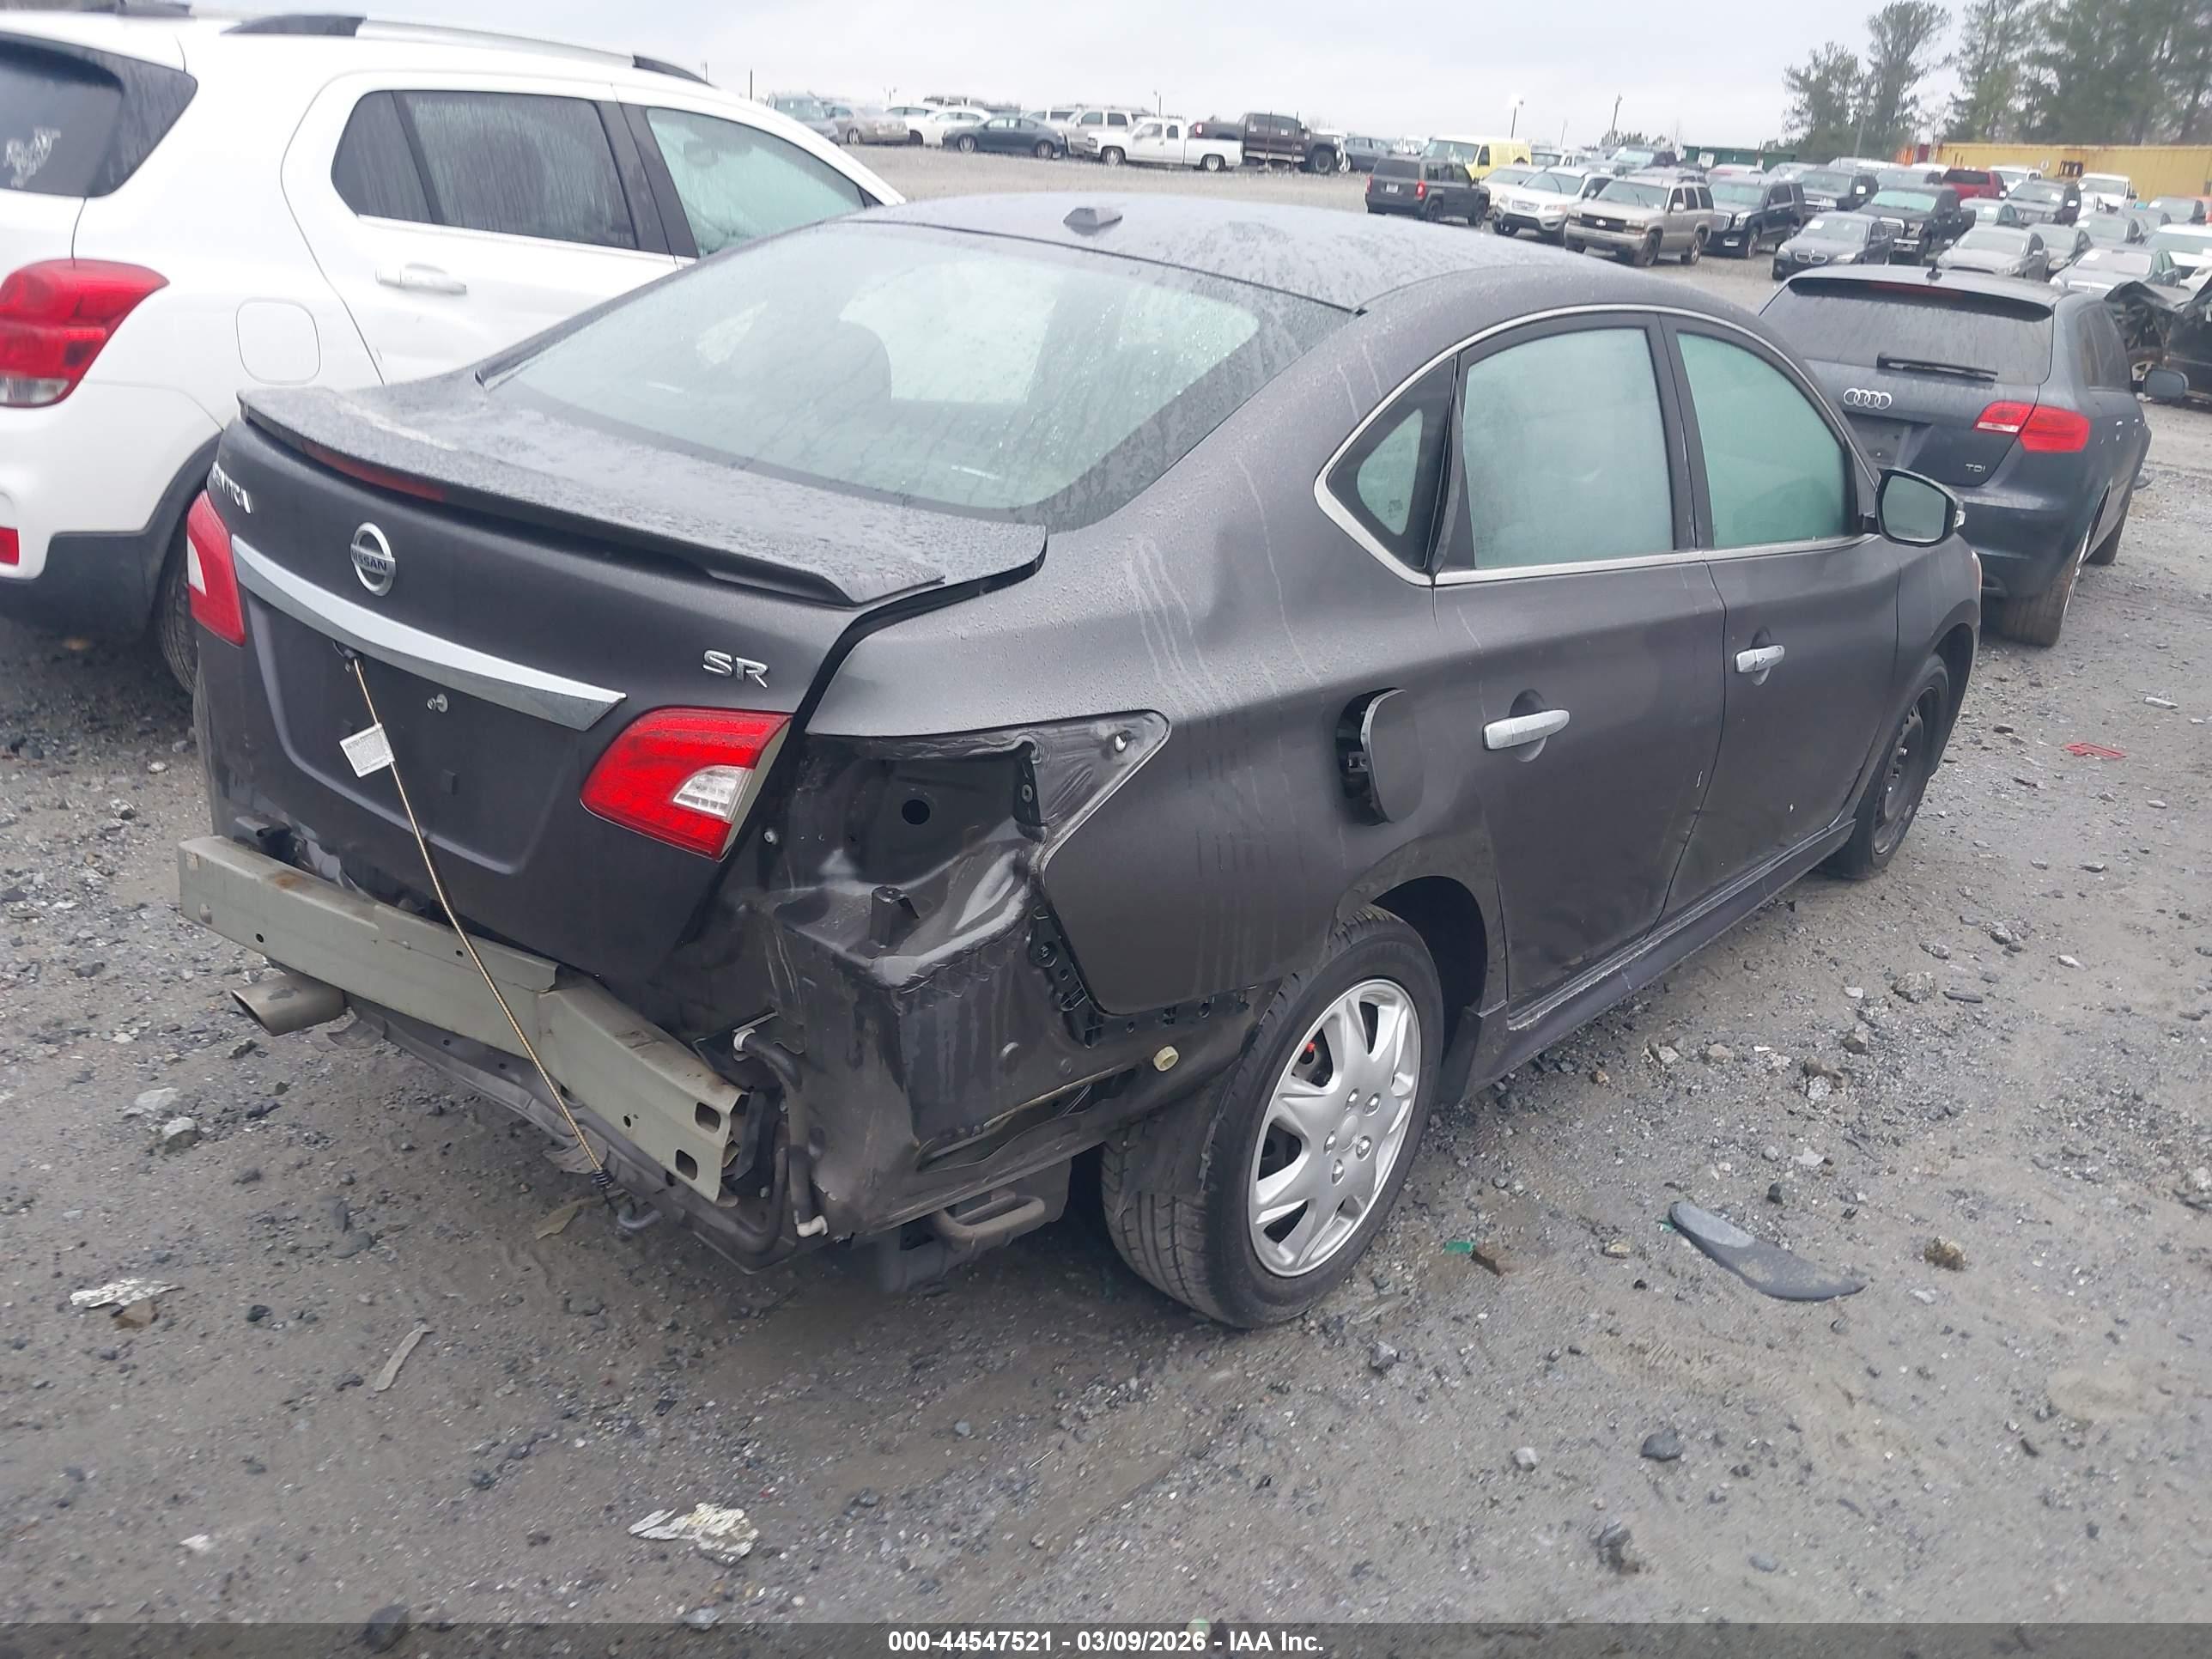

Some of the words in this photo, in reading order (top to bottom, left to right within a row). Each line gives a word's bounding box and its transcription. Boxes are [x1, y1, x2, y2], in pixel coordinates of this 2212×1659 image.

[1965, 463, 1986, 473] TDI
[350, 547, 388, 572] NISSAN
[702, 649, 769, 688] SR
